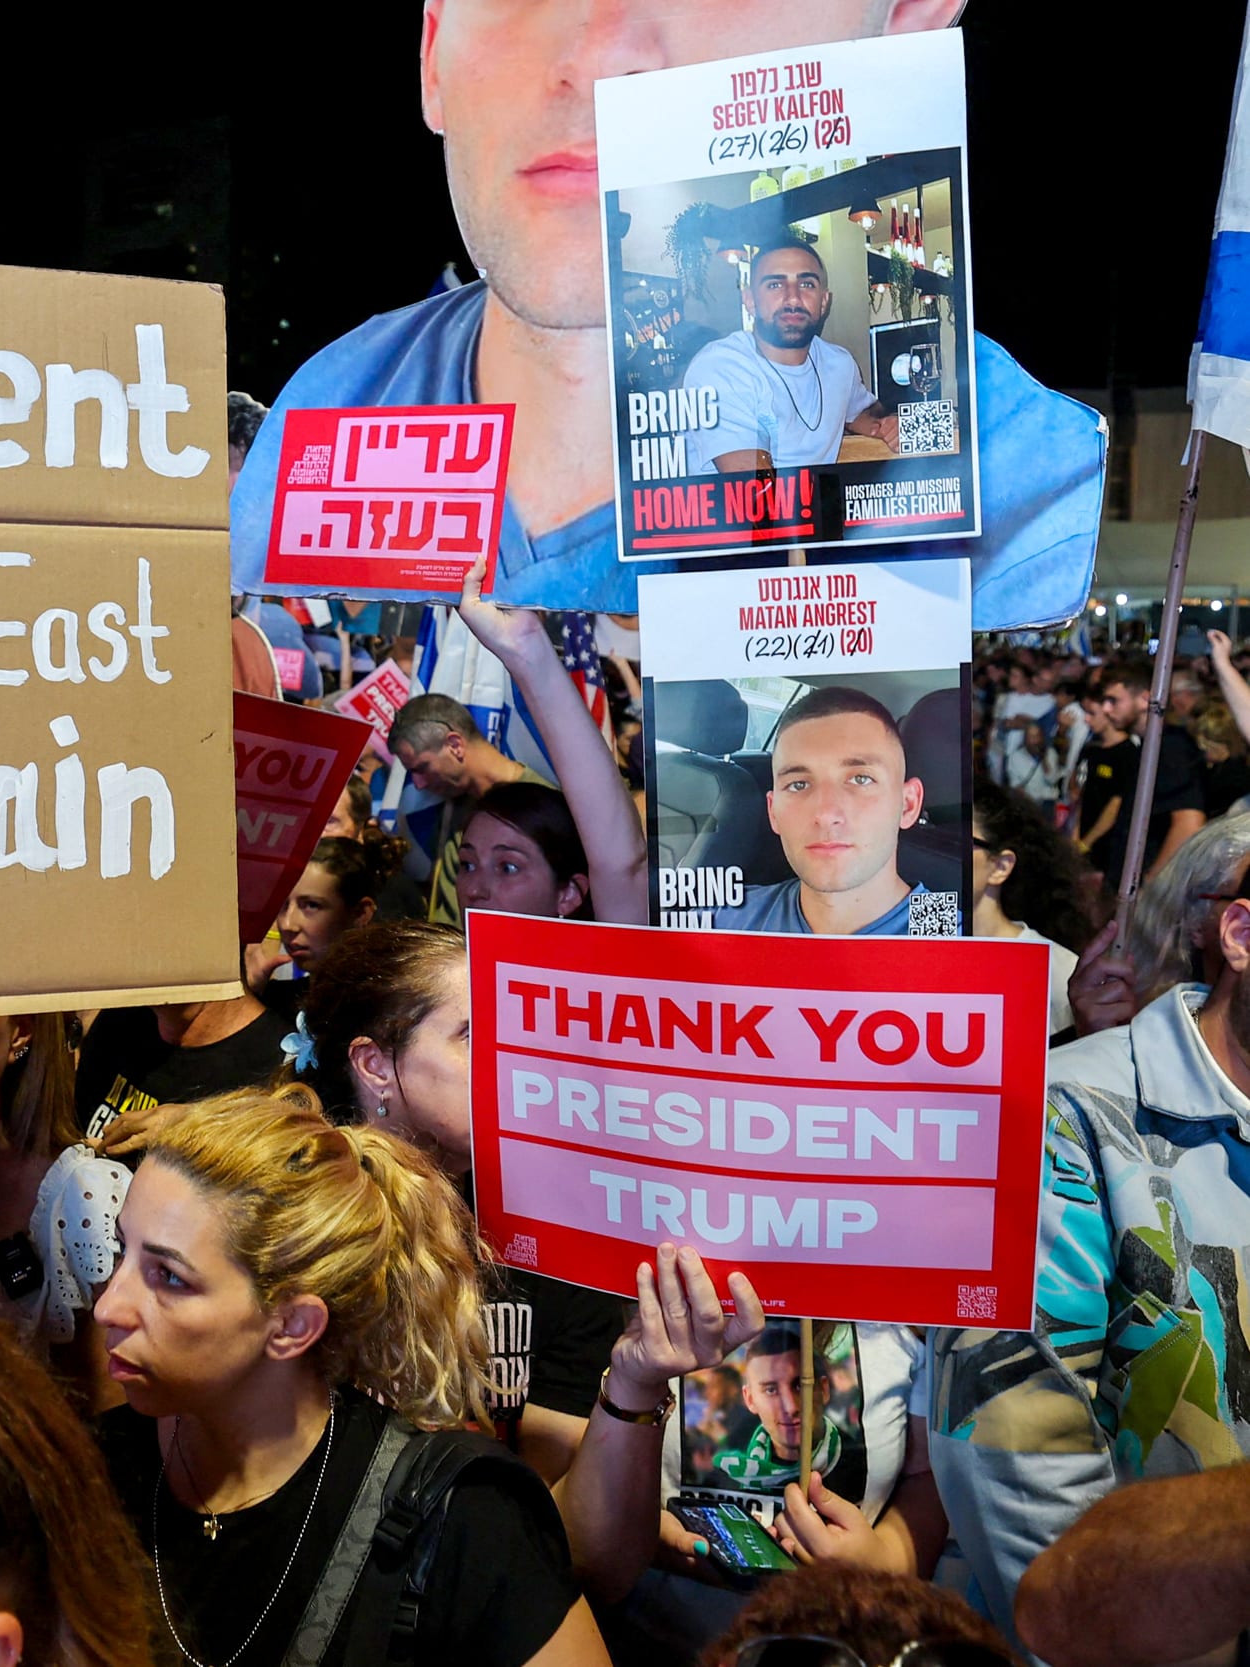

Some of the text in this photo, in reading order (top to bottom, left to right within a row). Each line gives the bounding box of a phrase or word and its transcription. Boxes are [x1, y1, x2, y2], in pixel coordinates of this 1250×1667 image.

[730, 61, 822, 102] שגב כלפון
[713, 88, 844, 131] SEGEV KALFON
[628, 386, 719, 435] BRING
[343, 422, 496, 483] עדיין
[631, 436, 687, 481] HIM
[632, 468, 814, 531] HOME NOW!
[845, 477, 961, 500] HOSTAGES AND MISSING
[845, 492, 963, 521] FAMILIES FORUM
[300, 499, 484, 553] בעזה.
[758, 574, 857, 602] מתן אנגרסט
[739, 601, 877, 630] MATAN ANGREST
[234, 742, 327, 791] YOU
[659, 866, 744, 907] BRING
[507, 979, 986, 1068] THANK YOU
[511, 1067, 979, 1163] PRESIDENT
[588, 1169, 879, 1250] TRUMP
